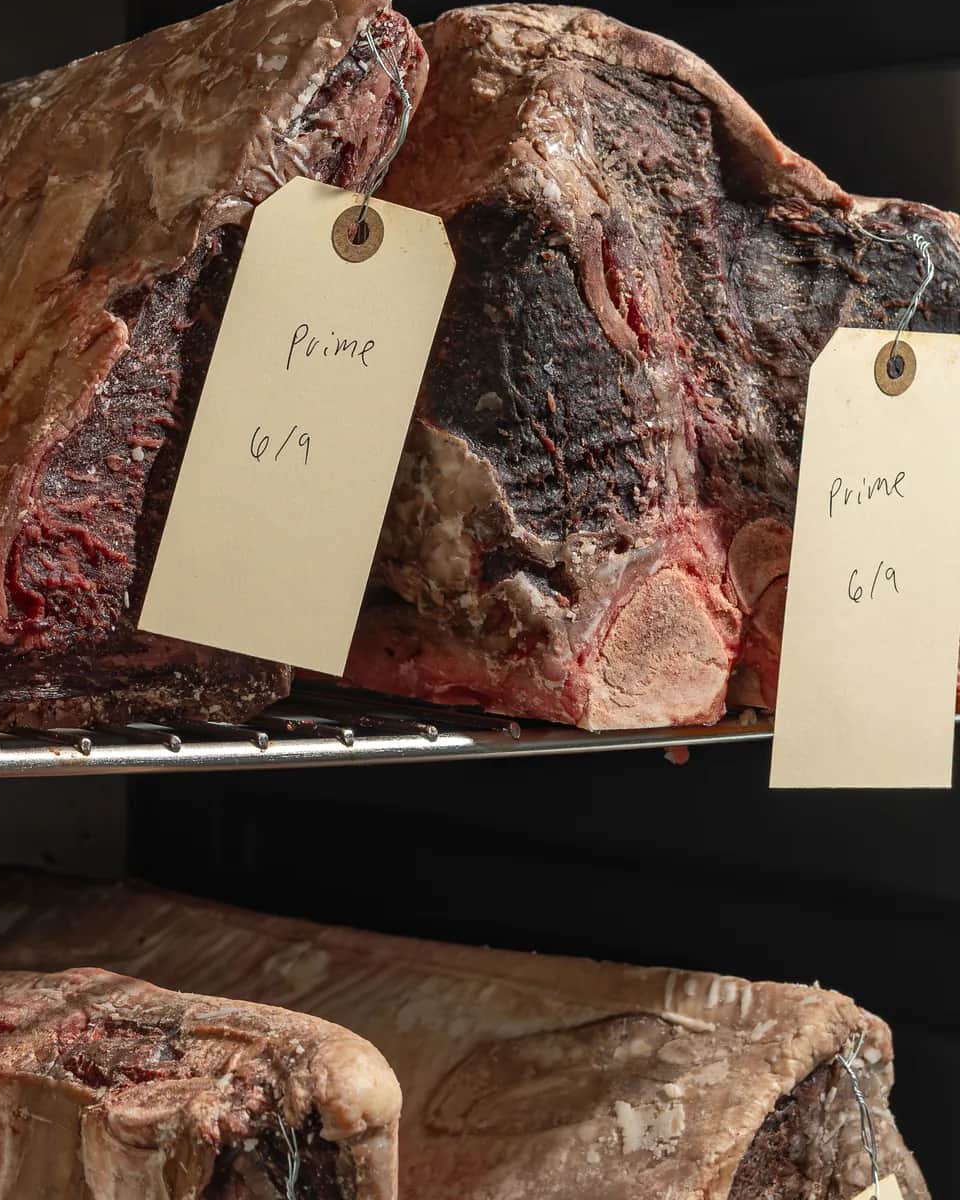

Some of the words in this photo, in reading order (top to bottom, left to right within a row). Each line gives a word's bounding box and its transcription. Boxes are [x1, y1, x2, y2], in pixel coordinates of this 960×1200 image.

[285, 324, 375, 370] Prime
[251, 425, 310, 465] 6/9
[829, 471, 906, 519] Prime
[847, 561, 900, 604] 6/9
